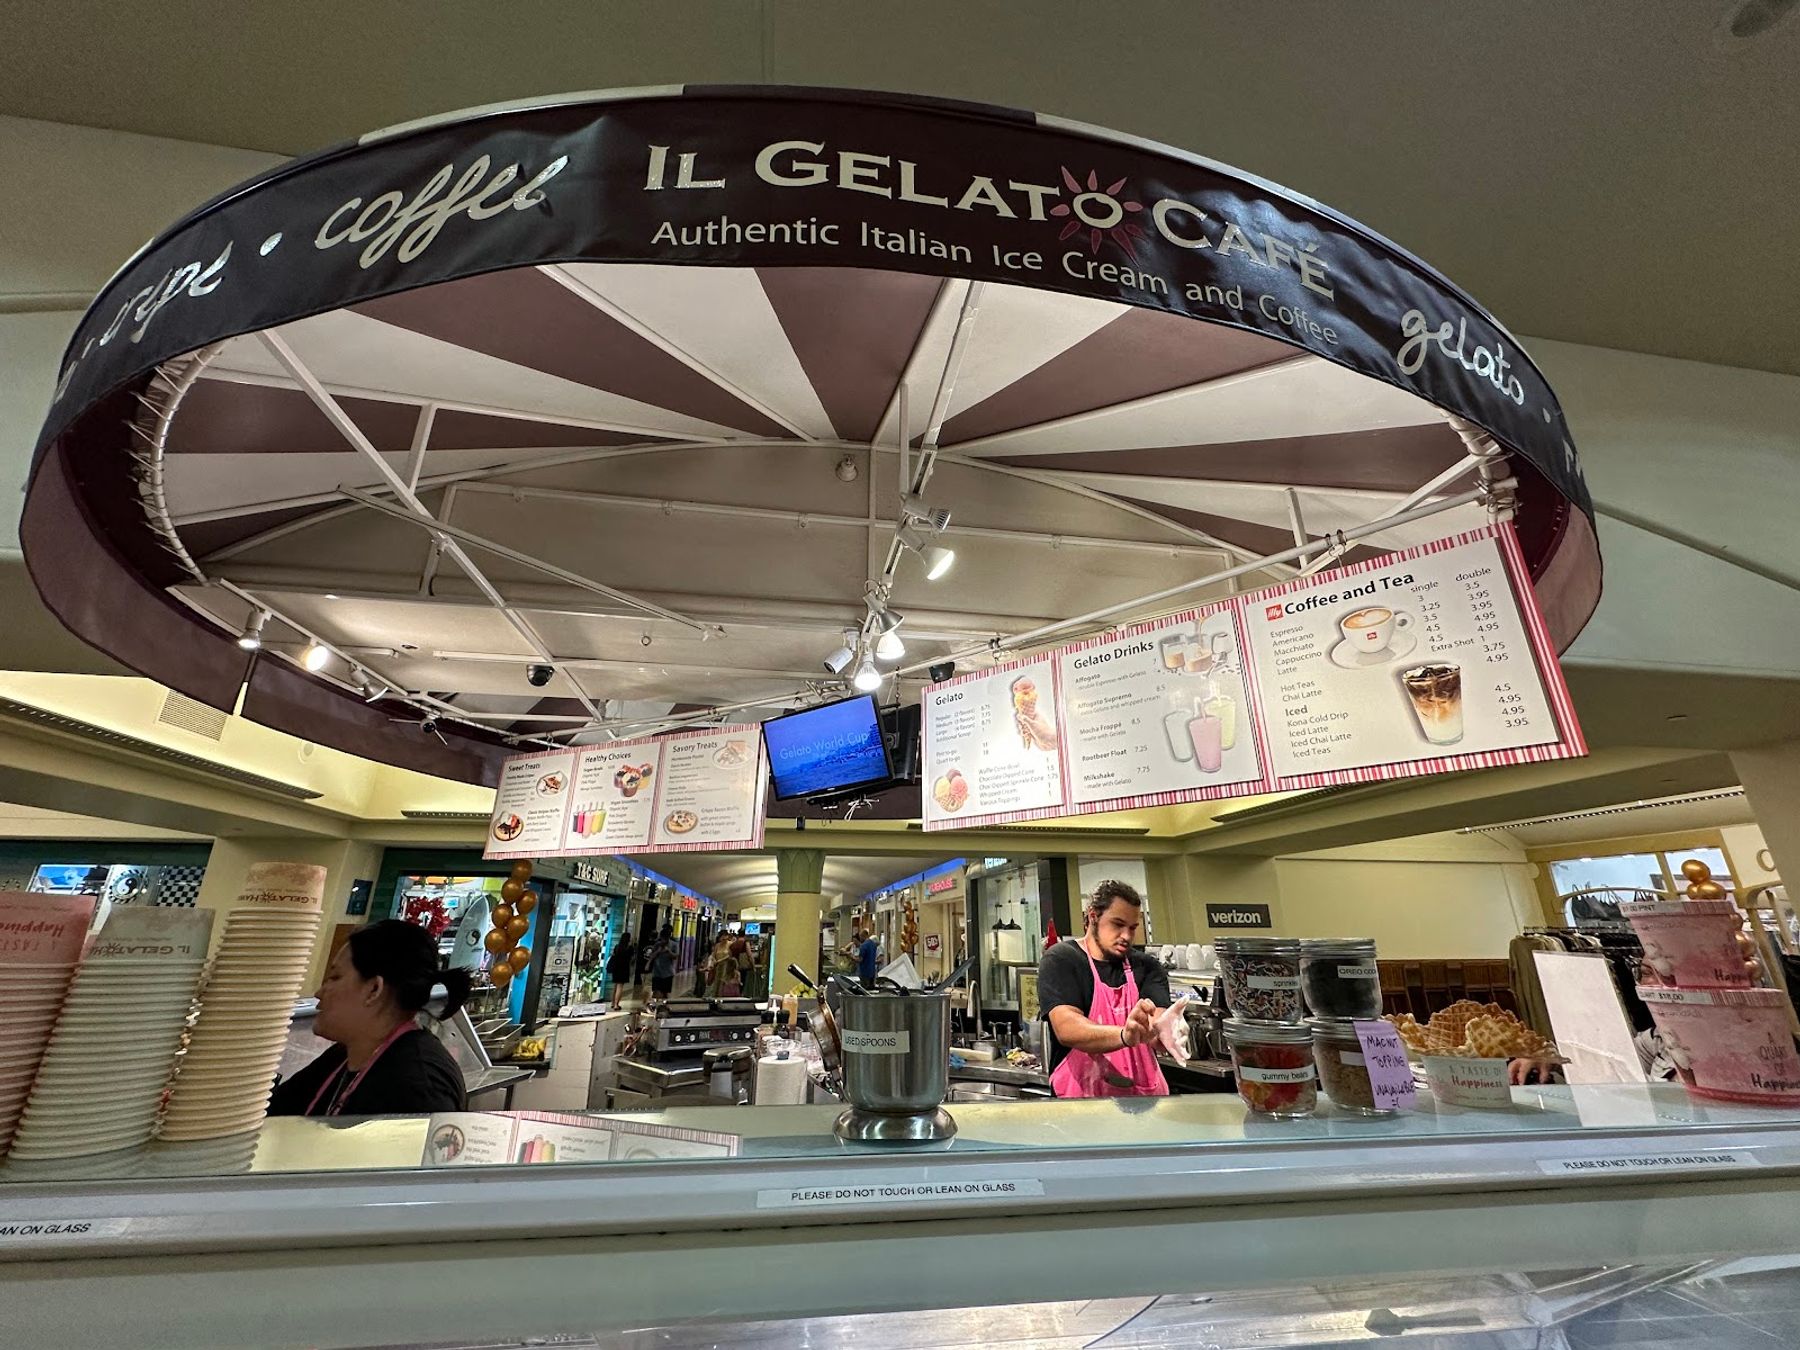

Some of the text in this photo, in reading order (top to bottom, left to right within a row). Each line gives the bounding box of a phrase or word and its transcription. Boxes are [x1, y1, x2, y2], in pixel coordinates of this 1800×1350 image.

[313, 153, 571, 270] coffee
[643, 139, 1335, 302] IL GELATO CAFÉ
[650, 216, 1339, 347] Authentic Italian Ice Cream and Coffee
[1396, 308, 1525, 407] gelato
[1410, 567, 1492, 593] single double
[1284, 594, 1338, 615] Coffee
[1342, 580, 1377, 601] and
[1379, 573, 1415, 590] Tea
[1270, 625, 1304, 639] Espresso
[1464, 580, 1481, 591] 3.5
[1271, 589, 1490, 648] Americano 3.25 3.95
[1273, 600, 1494, 657] Macchiato 3.5 3.95
[1275, 611, 1497, 666] Cappuccino 4.5 4.95
[1430, 642, 1453, 653] Extra
[1453, 638, 1475, 648] Shot
[1073, 641, 1154, 670] Gelato Drinks
[1277, 622, 1500, 676] Latte 4.5 4.95
[1280, 642, 1506, 692] Hot Teas 3.75
[1075, 673, 1101, 684] Affogato
[1282, 652, 1510, 702] Chai Latte 4.95
[935, 692, 964, 706] Gelato
[1103, 692, 1132, 704] Supremo
[1287, 683, 1512, 728] Kona Cold Drip 4.5
[1284, 704, 1309, 717] Iced
[1289, 693, 1522, 738] Iced Latte 4.95
[1079, 726, 1100, 735] Mocha
[1290, 705, 1526, 748] Iced Chai Latte 4.95
[672, 741, 718, 753] Savory Treats
[779, 731, 868, 760] Gelato World Cup
[1292, 717, 1530, 759] Iced Teas 3.95
[585, 752, 632, 763] Healthy Choices
[1082, 744, 1148, 762] Rootbeer Float 7.25
[508, 764, 524, 772] Sweet
[1083, 765, 1151, 782] Milkshake 7.75
[577, 861, 592, 879] T&C
[1210, 909, 1261, 924] verizon
[860, 1037, 897, 1047] SPOONS
[1371, 1055, 1406, 1070] TOPPING
[1261, 1073, 1290, 1081] gummy
[1451, 1074, 1504, 1089] Happiness
[1563, 1155, 1736, 1170] PLEASE DO NOT TOUCH OR LEAN ON GLASS
[791, 1182, 1016, 1201] PLEASE DO NOT TOUCH OR LEAN ON GLASS
[20, 1223, 92, 1236] ON GLASS
